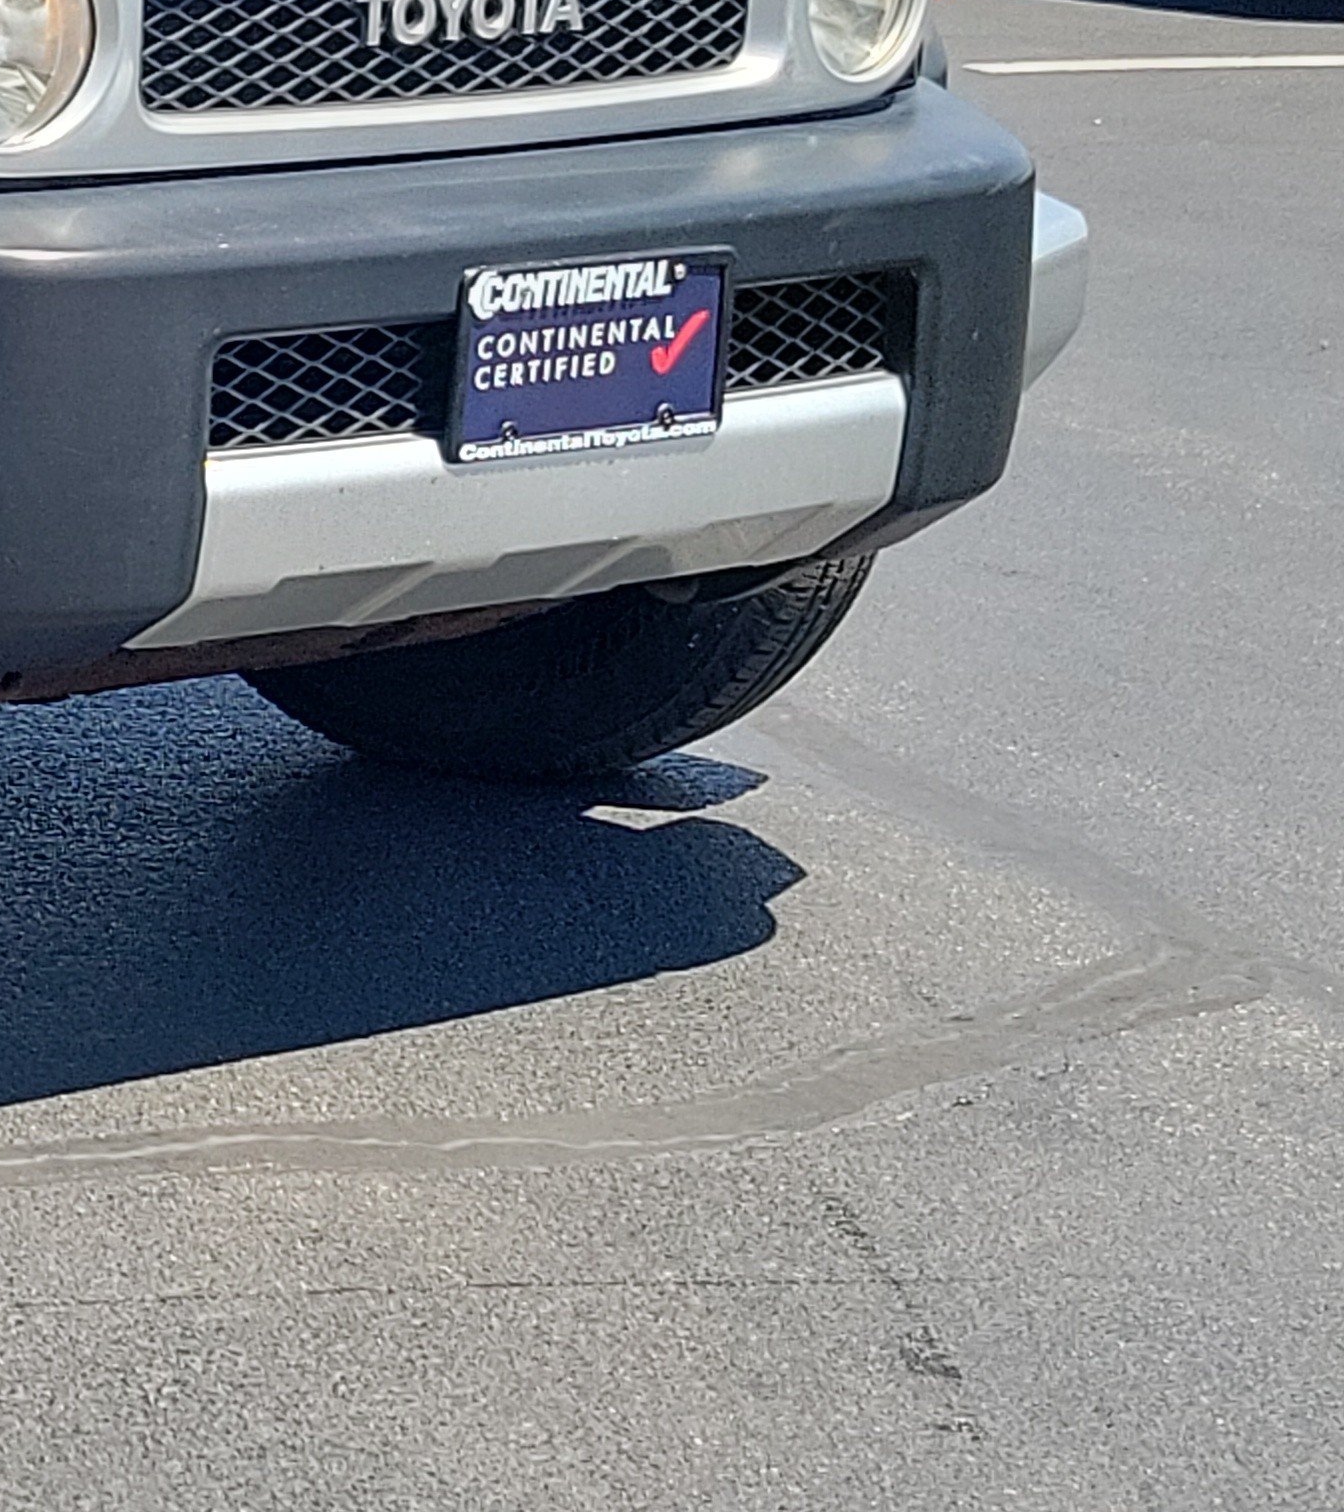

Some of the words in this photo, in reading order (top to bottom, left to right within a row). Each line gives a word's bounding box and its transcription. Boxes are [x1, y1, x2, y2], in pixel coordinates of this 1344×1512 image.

[468, 259, 672, 319] CONTINENTAL
[477, 315, 675, 360] CONTINENTAL
[473, 352, 616, 391] CERTIFIED
